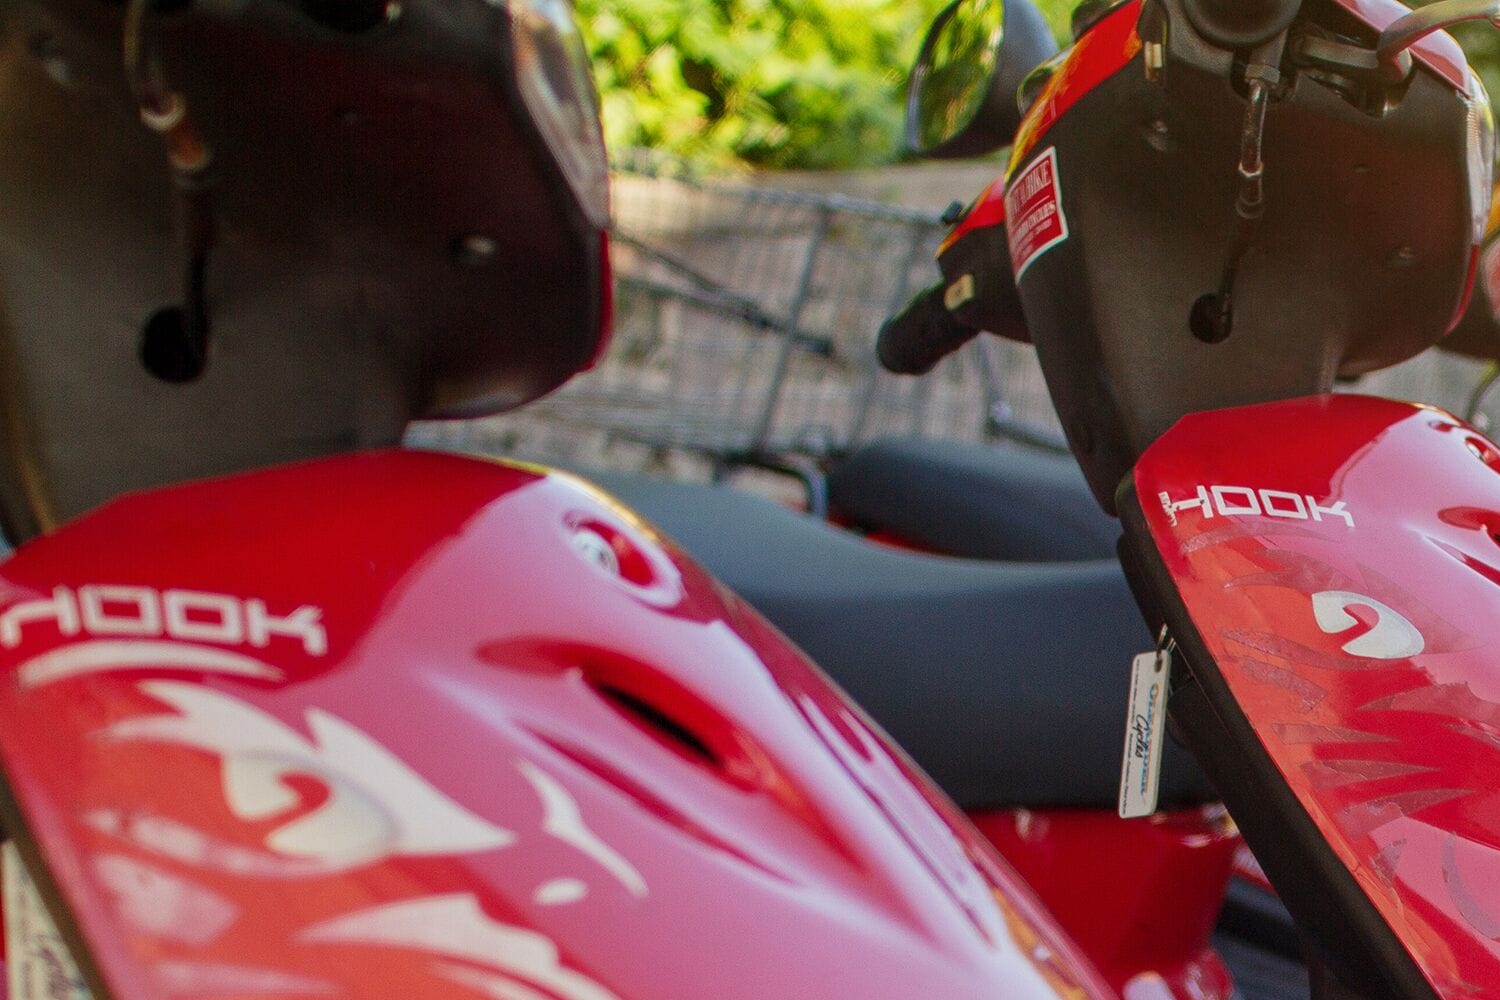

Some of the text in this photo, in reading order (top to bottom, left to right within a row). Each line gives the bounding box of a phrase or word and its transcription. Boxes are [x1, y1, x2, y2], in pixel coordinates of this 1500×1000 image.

[1158, 485, 1355, 528] HOOK
[0, 584, 328, 657] HOOK
[1132, 713, 1150, 759] Cycles
